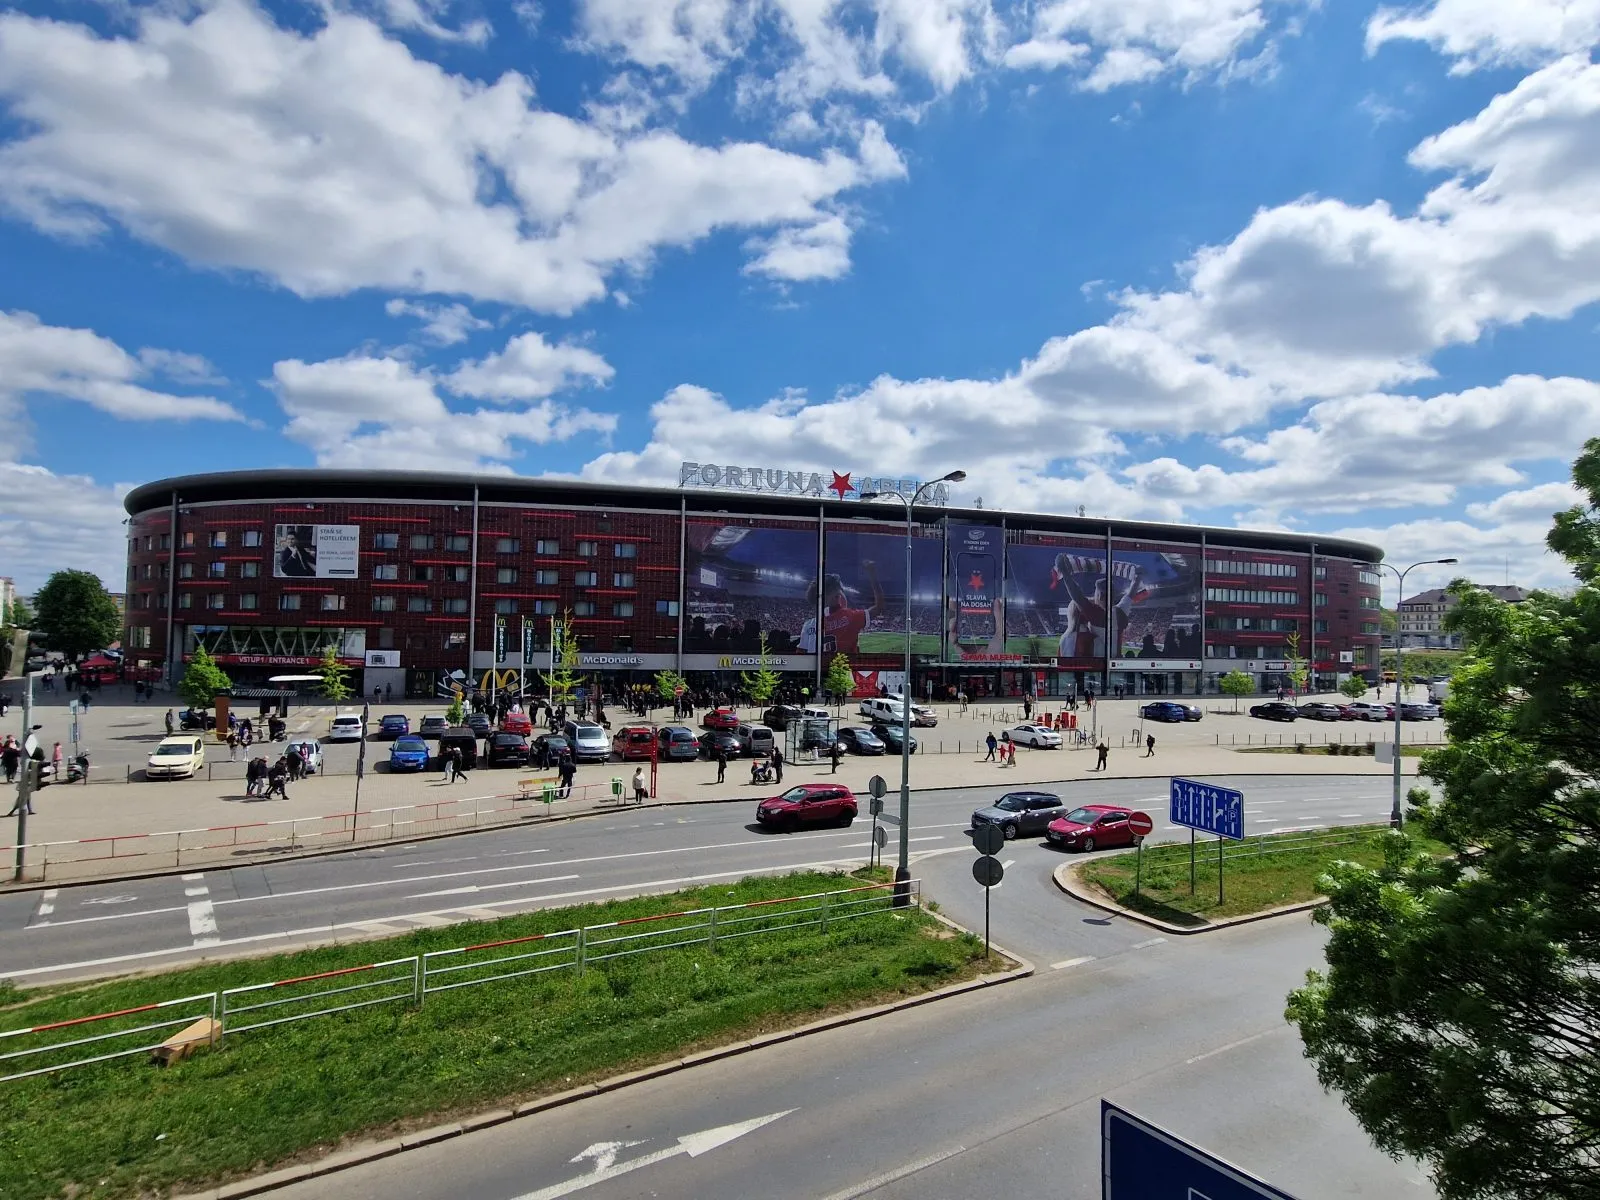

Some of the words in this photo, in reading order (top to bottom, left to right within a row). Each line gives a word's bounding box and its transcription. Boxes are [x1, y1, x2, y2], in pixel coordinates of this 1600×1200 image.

[681, 461, 824, 494] FORTUNA
[862, 476, 950, 502] ARENA
[583, 656, 644, 664] McDonald's
[732, 656, 788, 666] McDonald's
